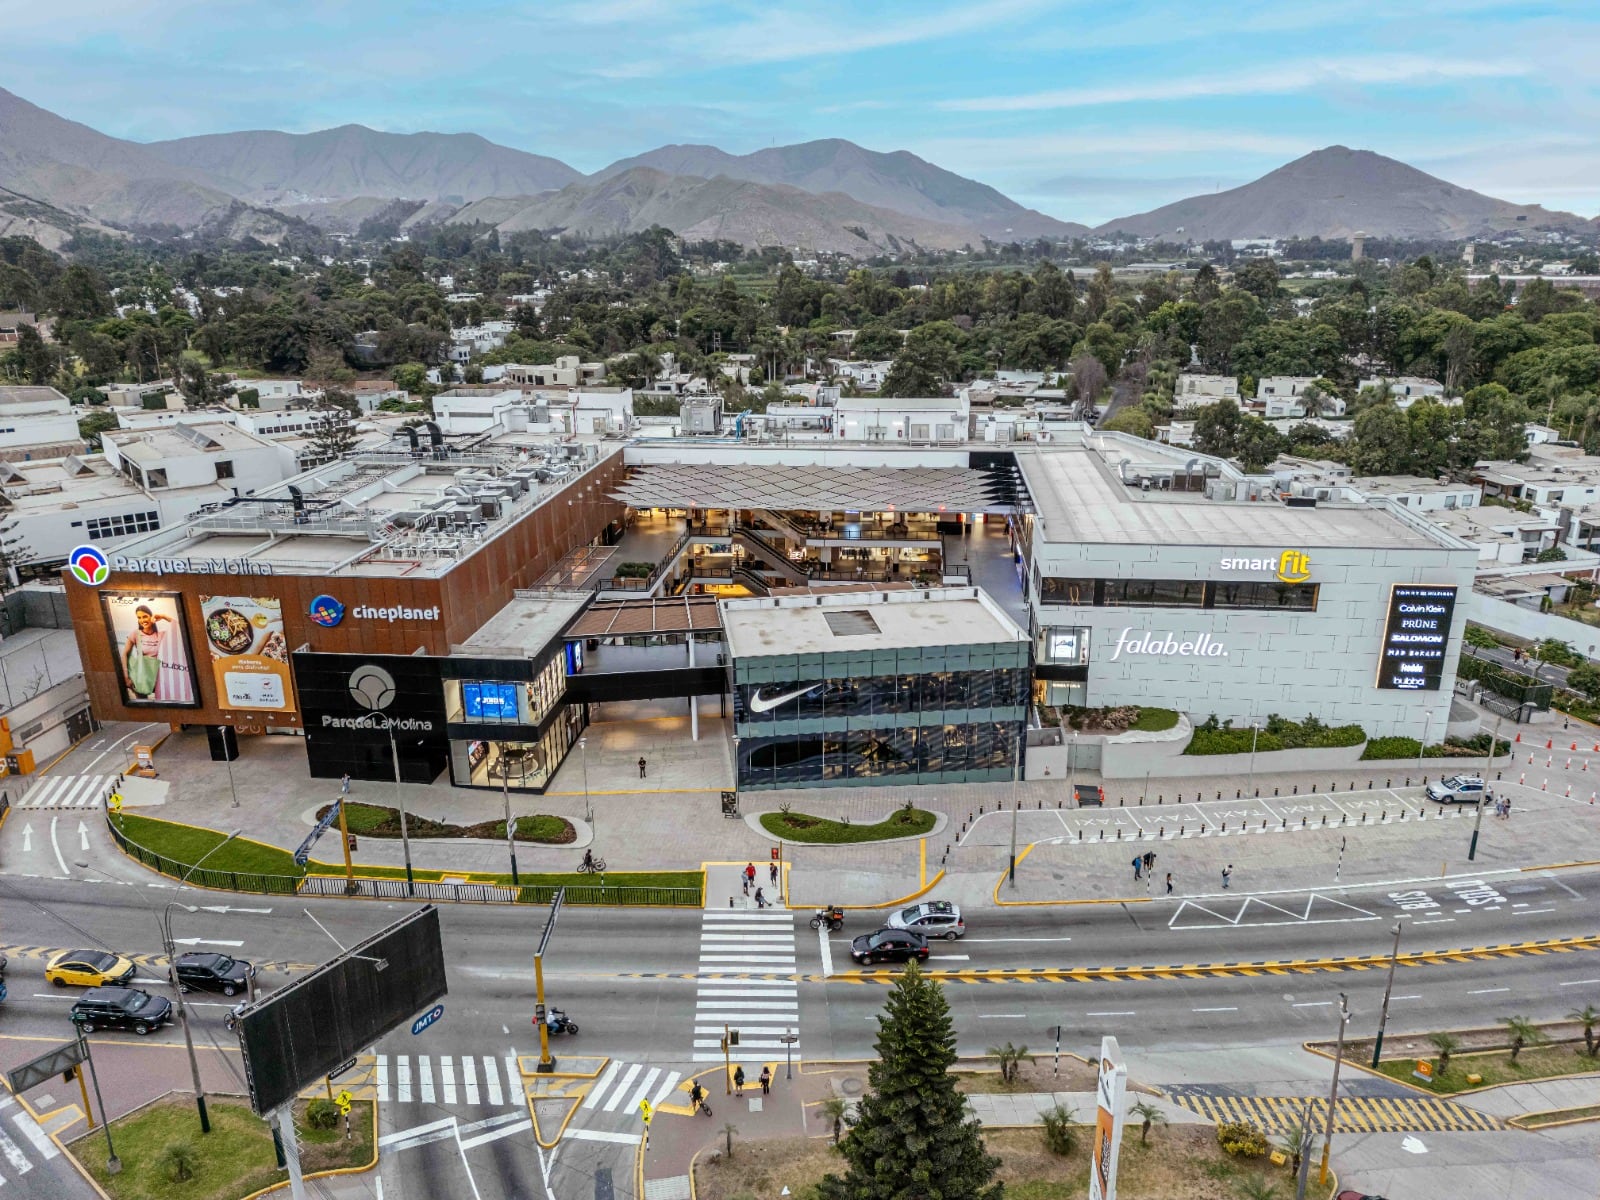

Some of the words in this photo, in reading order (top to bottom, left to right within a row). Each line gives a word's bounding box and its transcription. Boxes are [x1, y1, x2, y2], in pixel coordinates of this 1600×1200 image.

[115, 556, 272, 576] ParqueLaMolina
[1220, 557, 1277, 571] smart
[1279, 550, 1312, 574] fit
[1399, 604, 1425, 613] Calvin
[1426, 605, 1445, 613] Klein
[352, 605, 440, 622] cineplanet
[1402, 619, 1437, 629] PRÜNE
[1391, 634, 1443, 643] SALOMON
[1387, 649, 1406, 657] MAD
[1393, 677, 1425, 686] bubba
[321, 715, 433, 731] ParqueLaMolina
[1075, 818, 1128, 826] TAXI
[1144, 814, 1198, 823] TAXI
[1387, 890, 1441, 911] BUS
